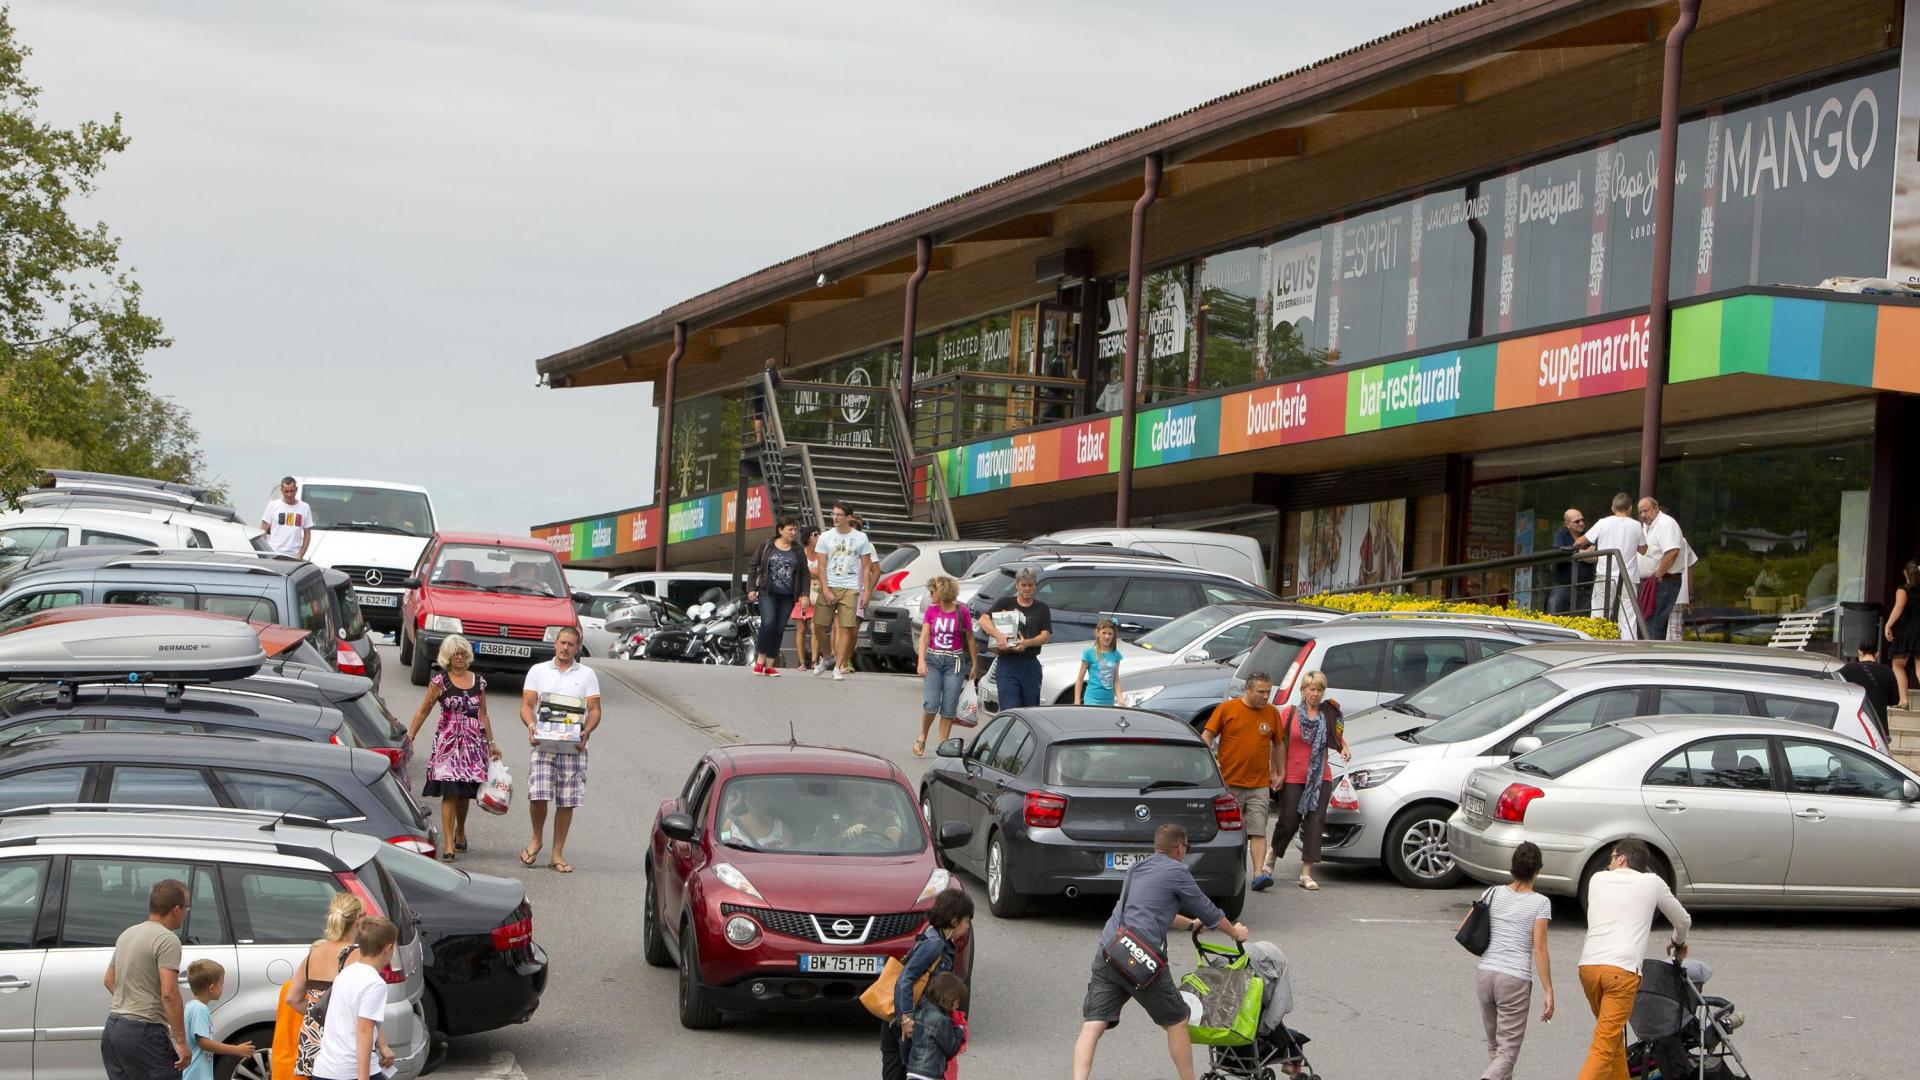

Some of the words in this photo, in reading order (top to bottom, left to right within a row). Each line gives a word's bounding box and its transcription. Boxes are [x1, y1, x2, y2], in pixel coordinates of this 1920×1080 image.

[1721, 87, 1879, 203] MANGO
[1611, 151, 1645, 218] Pepe
[1427, 207, 1451, 232] JACK
[1459, 195, 1491, 221] JONES
[1630, 222, 1656, 240] LONDO
[1343, 214, 1403, 280] ESPRIT
[1161, 283, 1176, 308] THE
[1148, 308, 1174, 336] NORTH
[943, 335, 979, 361] SELECTED
[982, 327, 1011, 363] PROM
[1098, 332, 1128, 359] TRESPAS
[1152, 332, 1175, 359] FACE
[1538, 314, 1651, 397] supermarché
[1359, 355, 1462, 418] bar-restaurant
[1246, 383, 1307, 436] boucherie
[1076, 423, 1105, 464] tabac
[1151, 408, 1198, 452] cadeaux
[976, 434, 1036, 484] maroquinerie
[632, 512, 648, 542] tabac
[669, 498, 704, 539] maroquinerie
[158, 644, 199, 652] BERMUDE
[480, 643, 504, 655] 6388
[504, 645, 517, 655] PH
[517, 647, 530, 657] 40
